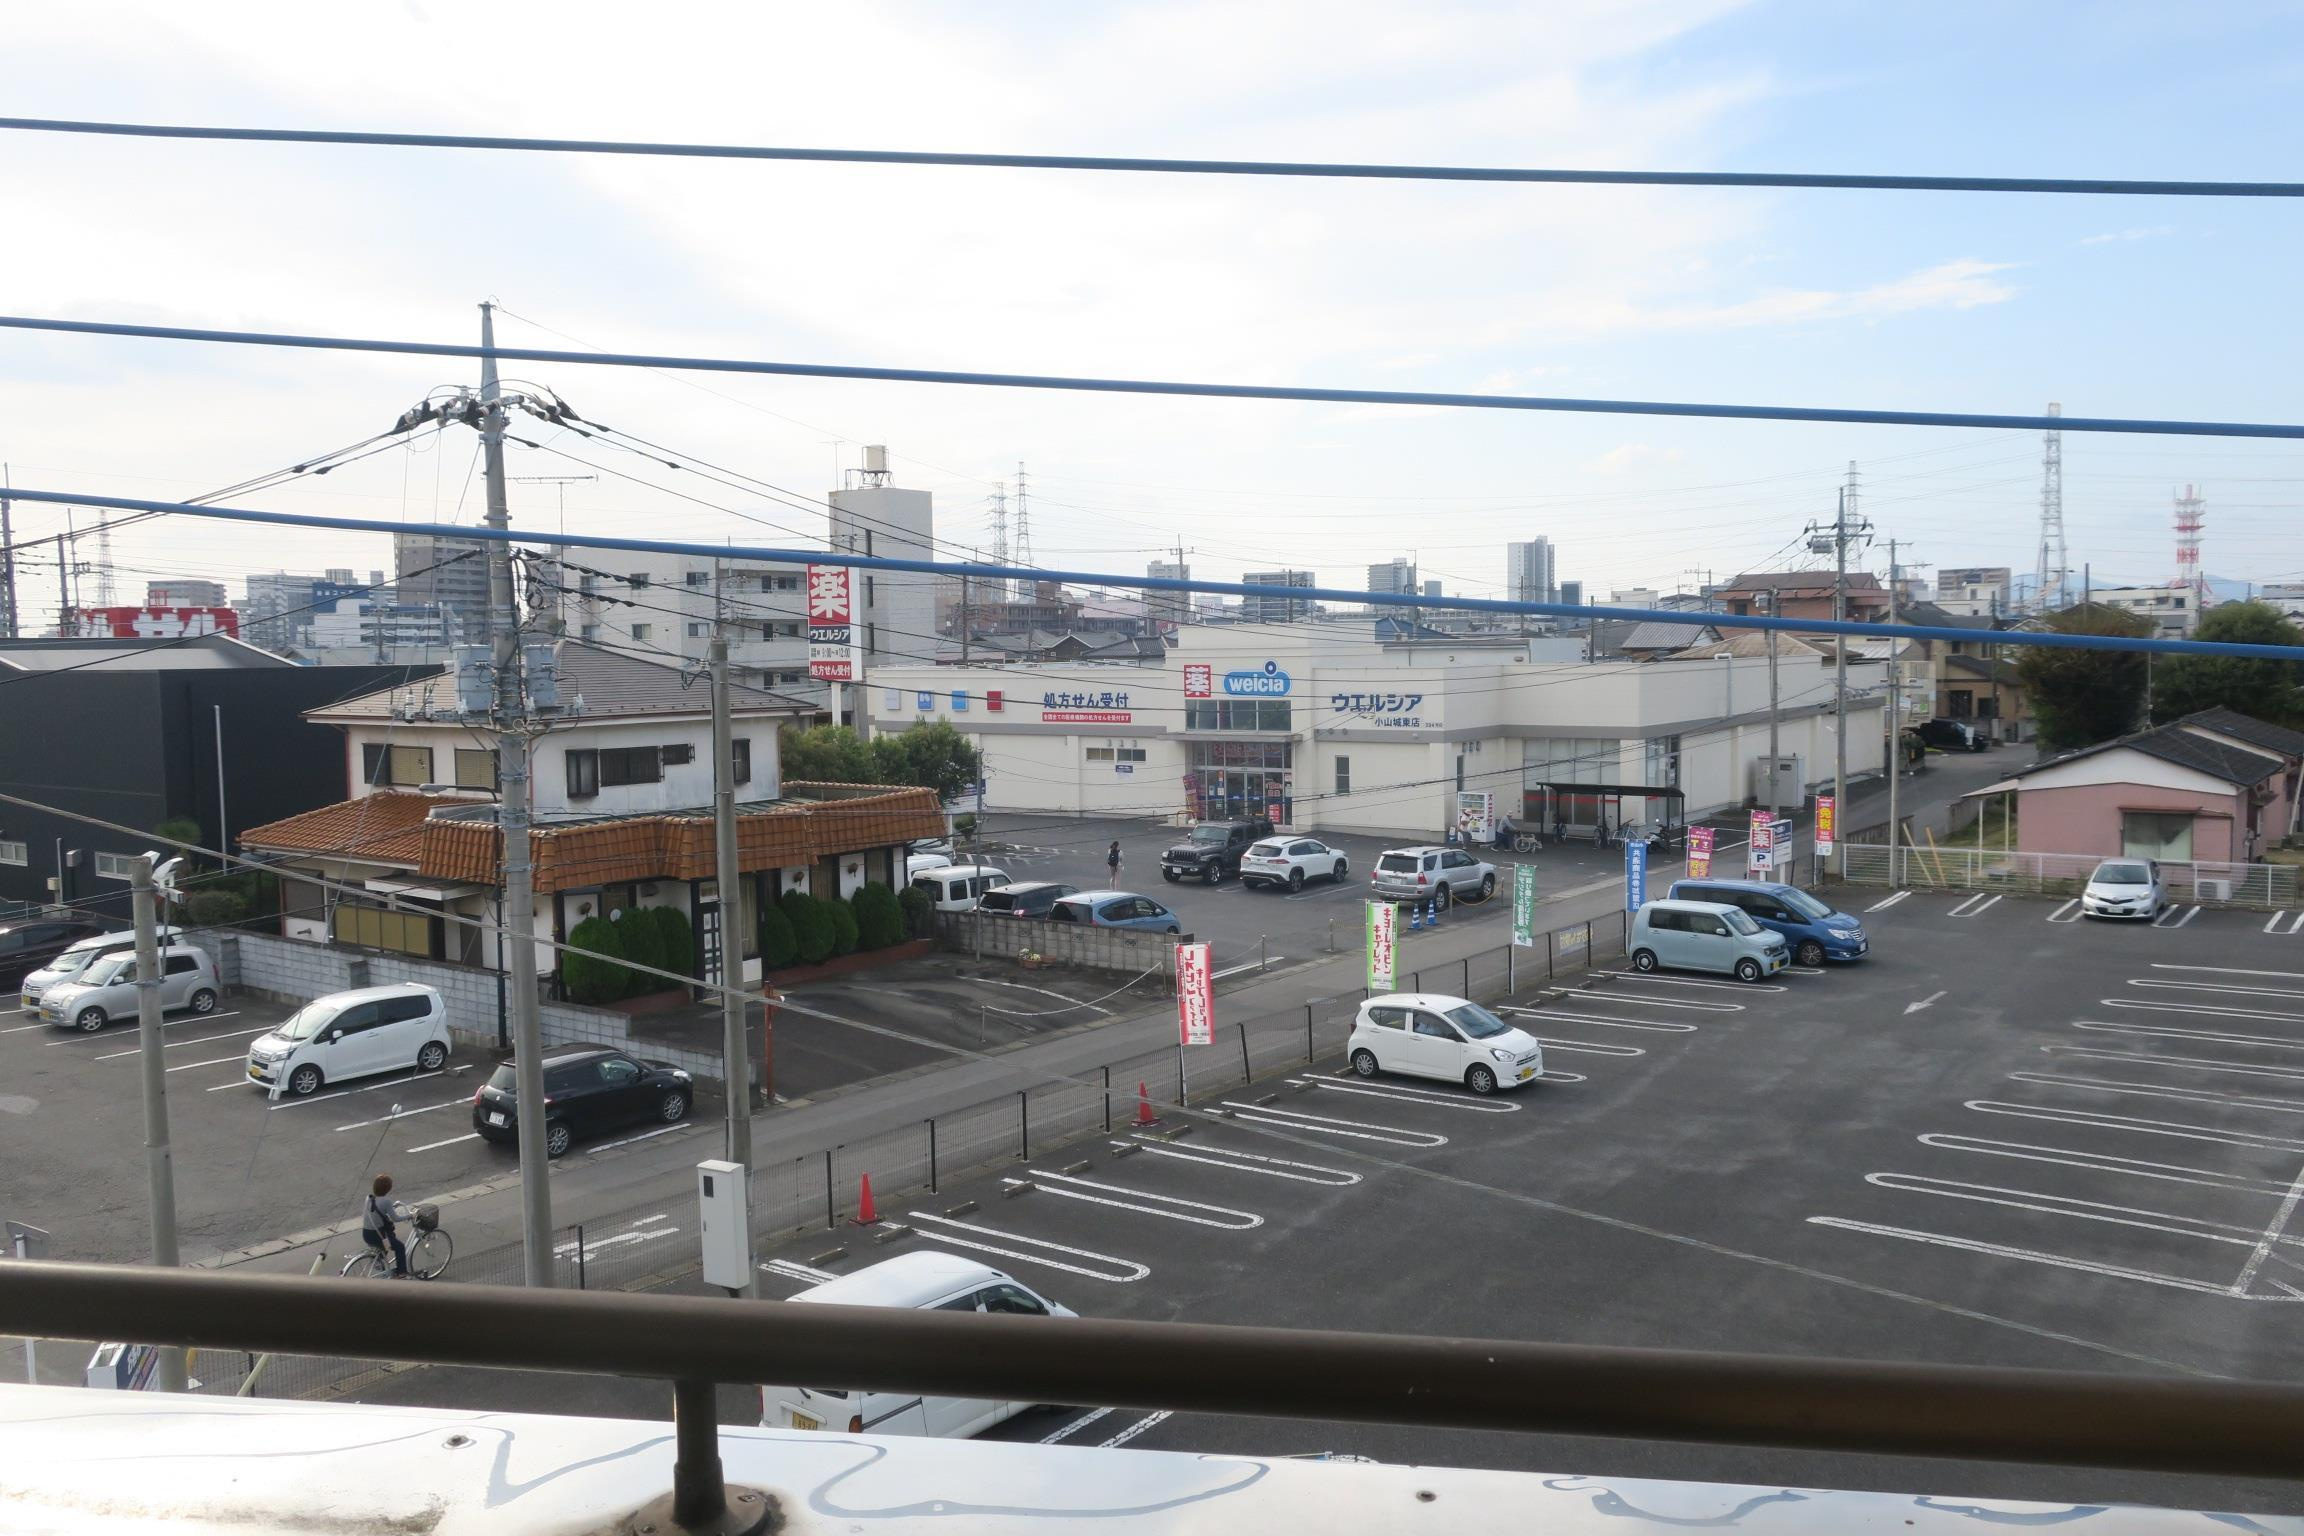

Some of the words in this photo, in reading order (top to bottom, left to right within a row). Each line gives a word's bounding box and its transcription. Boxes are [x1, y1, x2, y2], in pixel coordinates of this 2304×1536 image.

[809, 565, 848, 618] 薬
[810, 628, 850, 641] ウエルシア
[811, 664, 850, 676] 処方せん受付
[1185, 666, 1211, 697] 薬
[1228, 667, 1284, 692] welcia
[1043, 691, 1129, 709] 処方せん受付
[1331, 693, 1423, 712] ウエルシア
[1375, 717, 1420, 728] 小山城東店
[1753, 830, 1770, 847] 薬
[1757, 854, 1766, 863] P
